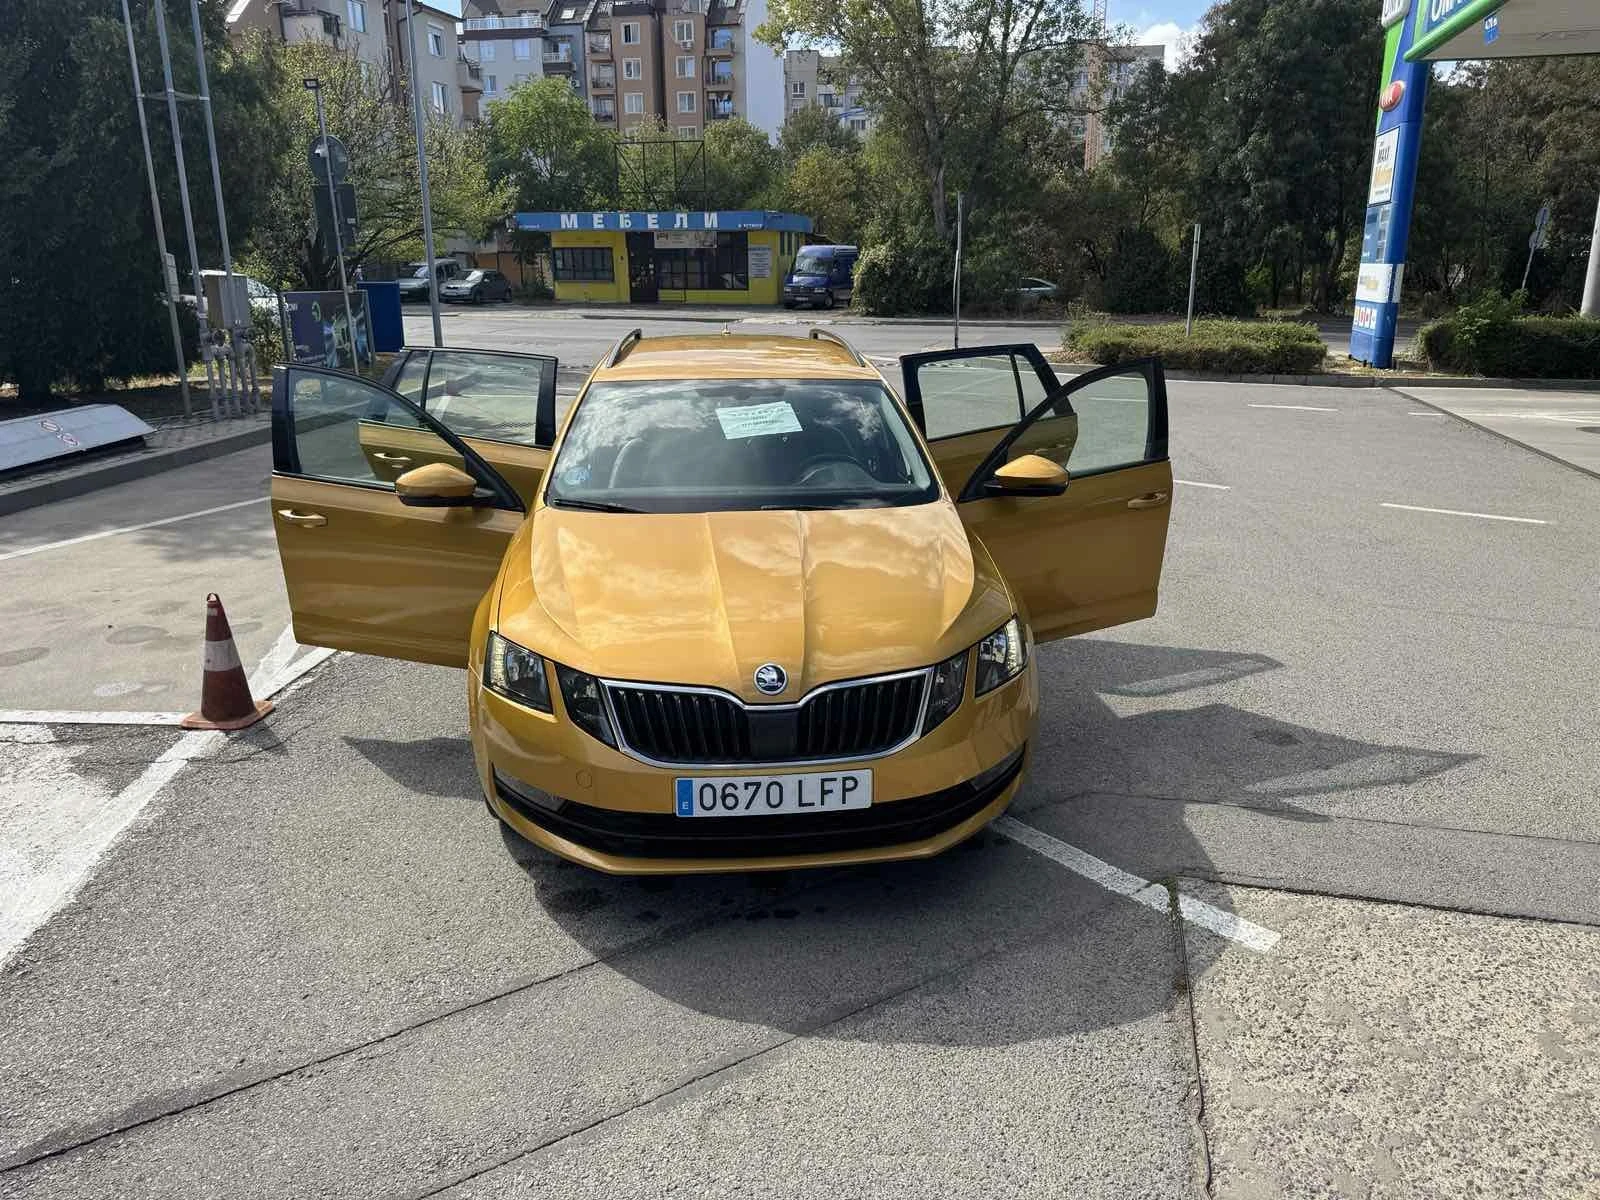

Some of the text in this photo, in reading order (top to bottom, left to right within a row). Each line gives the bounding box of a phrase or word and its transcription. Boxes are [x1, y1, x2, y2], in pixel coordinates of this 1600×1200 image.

[560, 212, 719, 229] МЕБЕЛИ
[682, 776, 859, 811] E 0670 LFP
